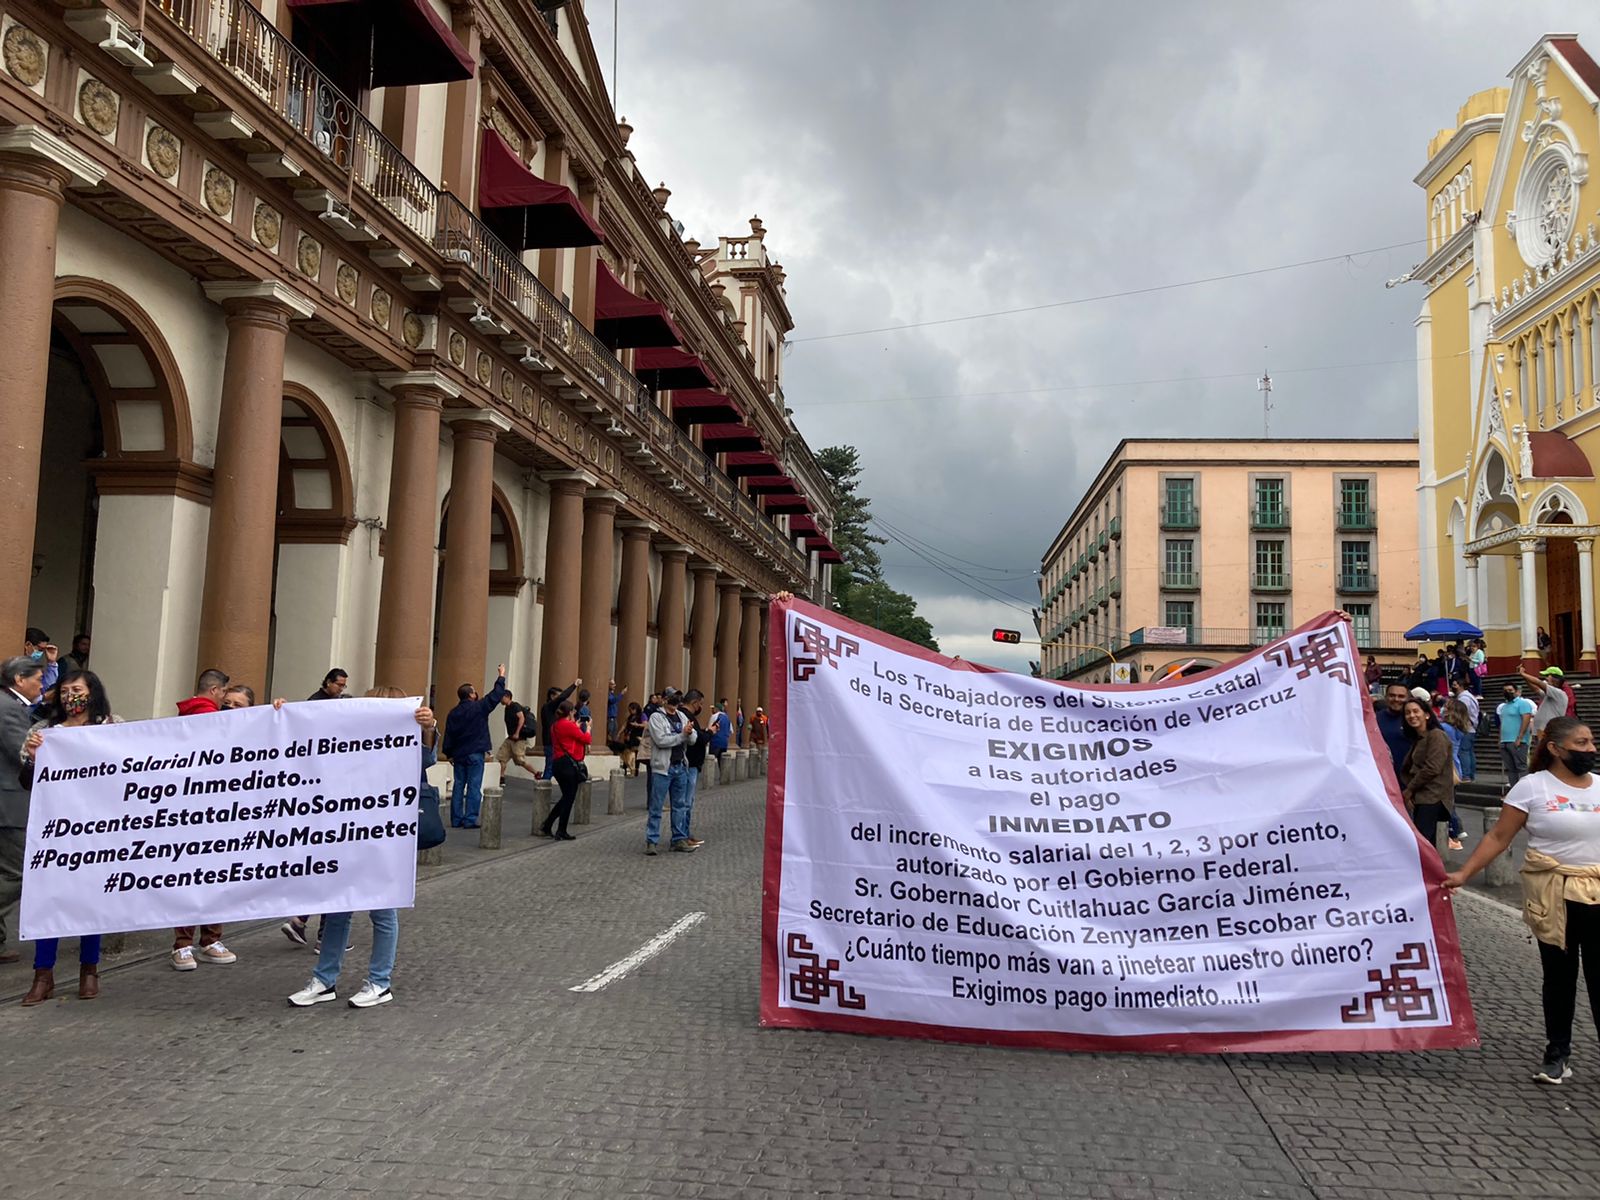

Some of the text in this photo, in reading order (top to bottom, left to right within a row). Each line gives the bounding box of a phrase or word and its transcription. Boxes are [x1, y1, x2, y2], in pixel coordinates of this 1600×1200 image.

[873, 661, 908, 686] Los
[913, 674, 1046, 709] Trabajadores
[1053, 692, 1084, 709] del
[1188, 667, 1261, 699] Estatal
[850, 678, 1296, 733] de la Secretaría de Educación de Veracruz
[38, 733, 418, 783] Aumento Salarial No Bono del Bienestar.
[988, 738, 1152, 761] EXIGIMOS
[124, 770, 321, 804] Pago Inmediato...
[968, 759, 1177, 785] a las autoridades
[1030, 792, 1120, 811] el pago
[989, 811, 1171, 833] INMEDIATO
[851, 822, 1346, 864] del incremento salarial del 1, 2, 3 por ciento,
[104, 857, 338, 893] #DocentesEstatales
[896, 854, 1299, 893] autorizado por el Gobierno Federal.
[855, 878, 1350, 918] Sr. Gobernador Cuitlahuac García Jiménez,
[810, 900, 1414, 948] Secretario de Educación Zenyanzen Escobar García.
[845, 936, 1373, 981] ¿Cuánto tiempo más van a jinetear nuestro dinero?
[953, 976, 1047, 1005] Exigimos
[1055, 986, 1106, 1011] pago
